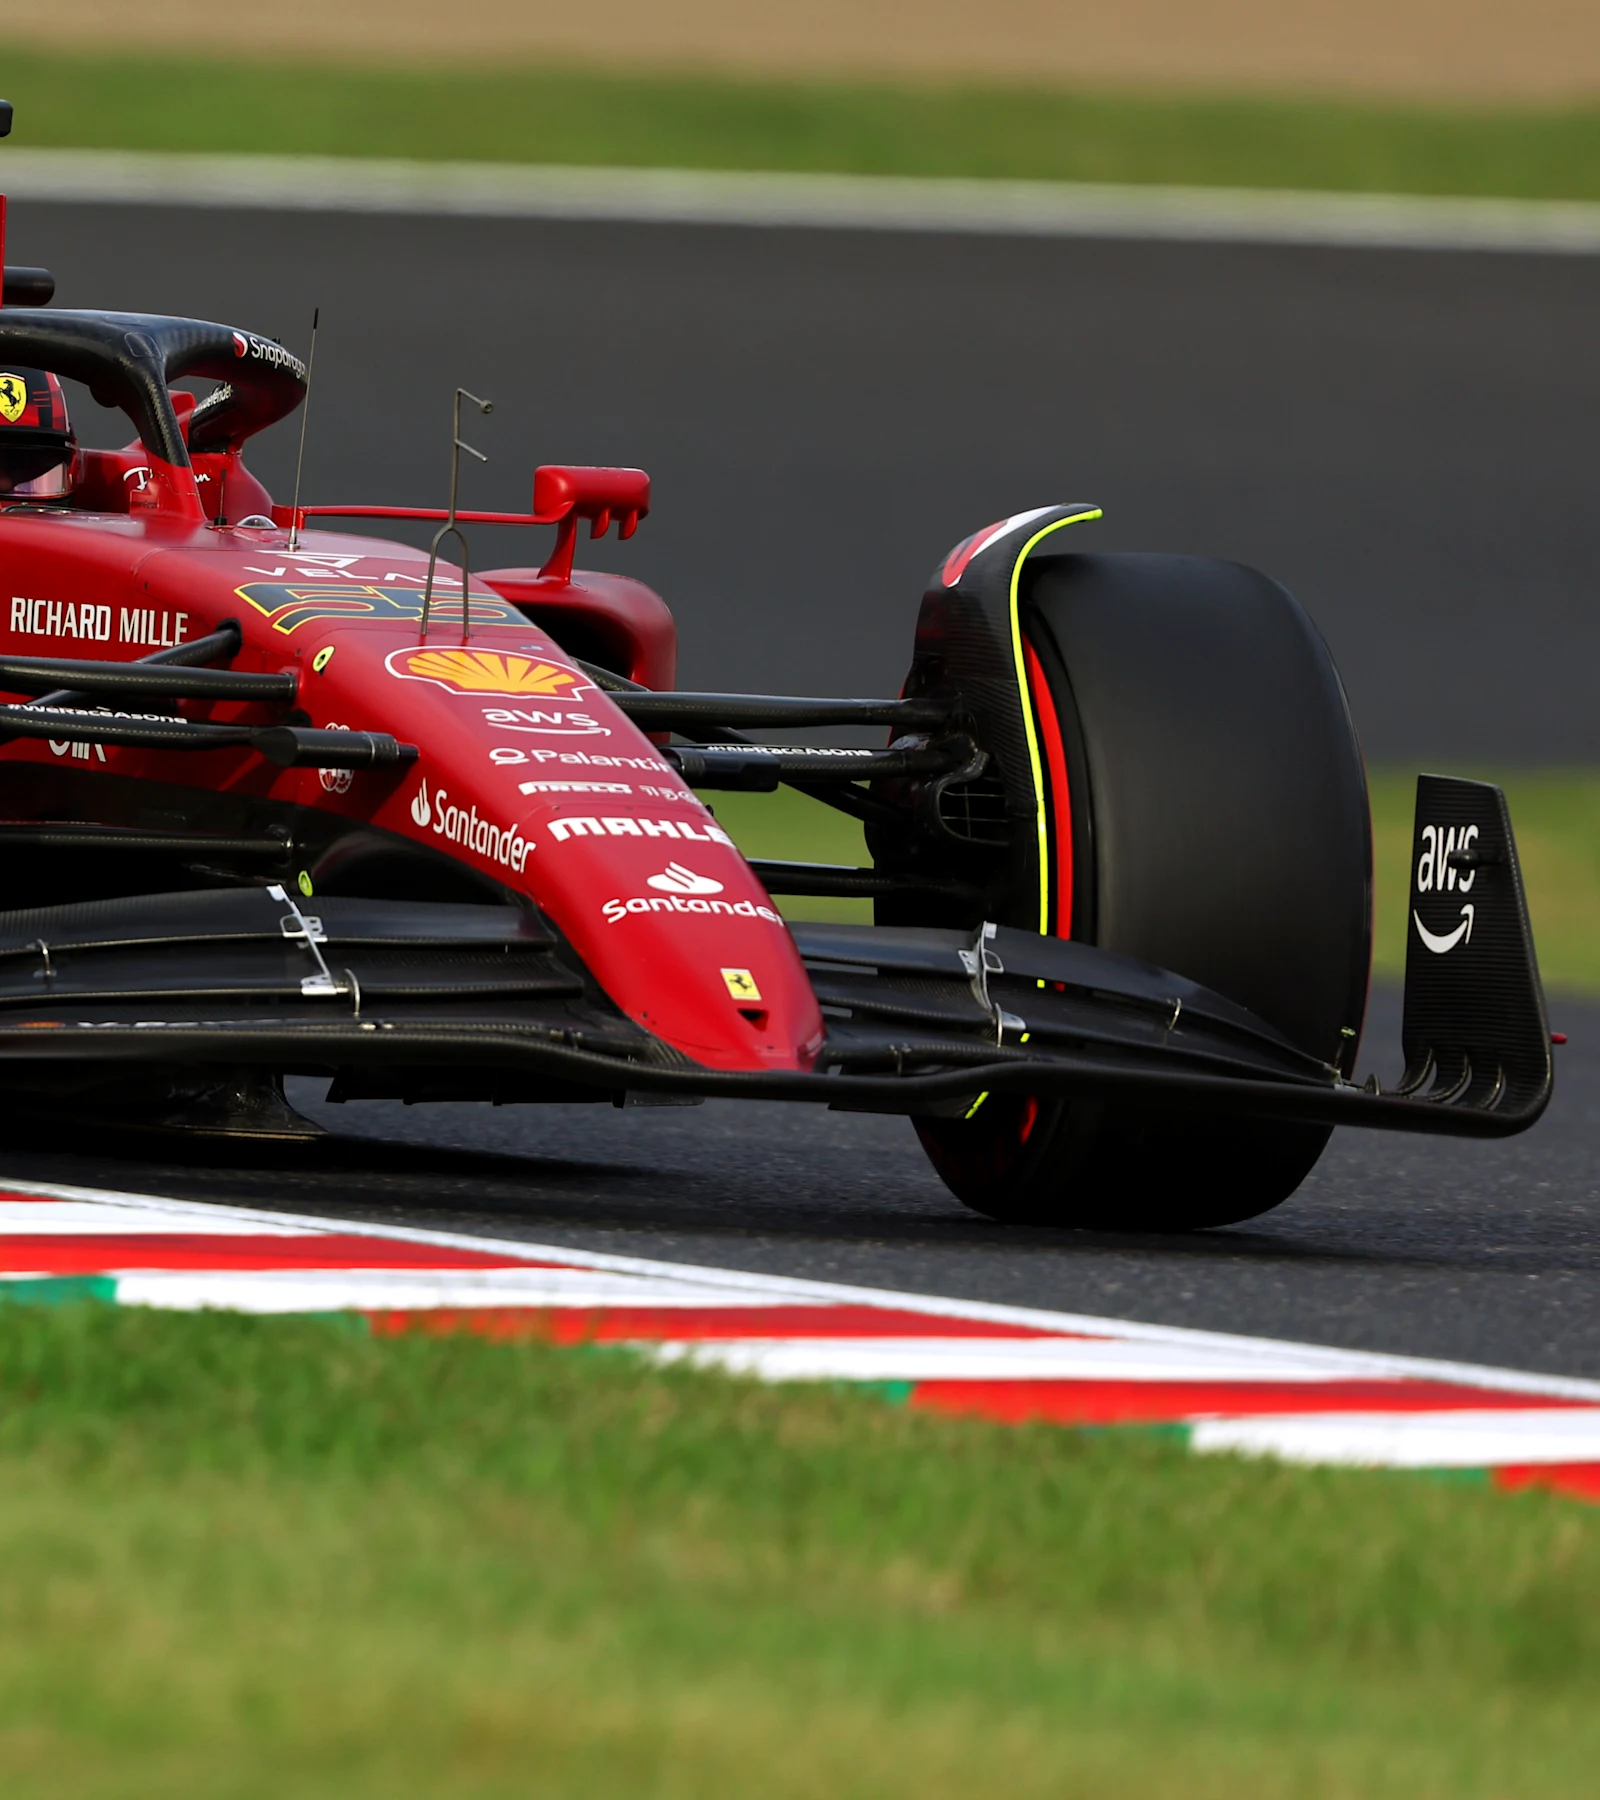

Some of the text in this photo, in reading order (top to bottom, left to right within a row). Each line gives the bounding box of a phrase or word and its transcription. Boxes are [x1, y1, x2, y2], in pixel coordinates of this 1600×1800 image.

[243, 566, 464, 586] VELAS
[10, 596, 189, 647] RICHARD MILLE
[233, 582, 542, 635] 55
[7, 703, 188, 725] #WeRaceAsOne
[481, 708, 600, 728] aws
[517, 780, 633, 796] PIRELLI
[433, 789, 537, 873] Santander
[547, 816, 737, 850] MAHLE
[1417, 825, 1479, 893] aws
[602, 895, 785, 927] Santander
